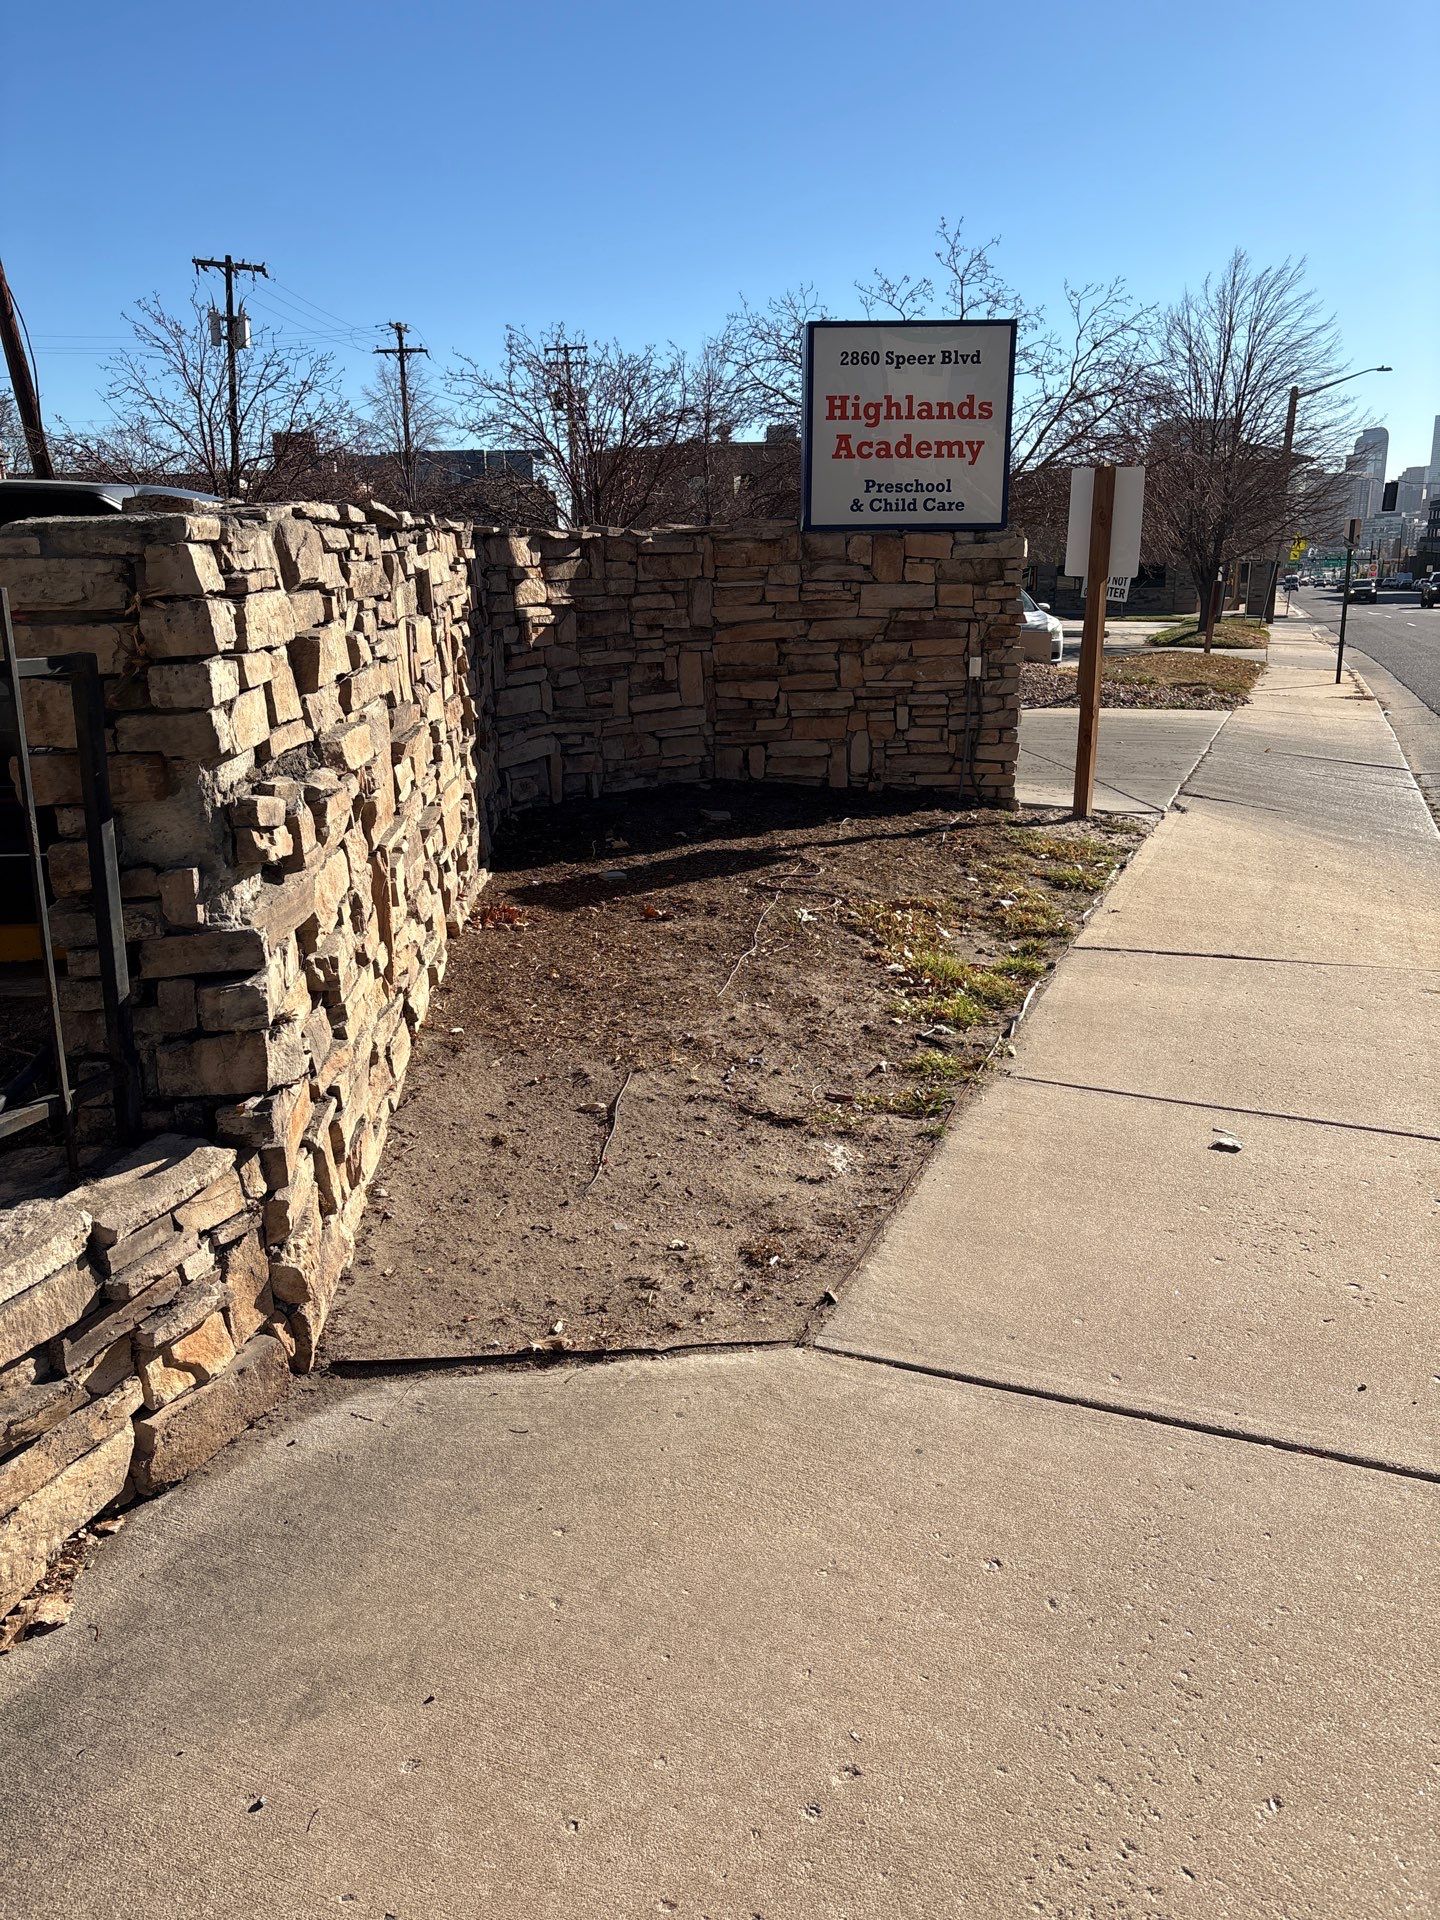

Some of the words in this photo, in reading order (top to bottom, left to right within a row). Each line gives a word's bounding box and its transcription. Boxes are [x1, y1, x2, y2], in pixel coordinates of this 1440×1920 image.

[840, 351, 880, 366] 2860
[885, 350, 936, 369] Speer
[940, 350, 982, 365] Blvd
[825, 394, 993, 428] Highlands
[831, 433, 985, 466] Academy
[864, 479, 952, 493] Preschool
[849, 498, 864, 512] &
[869, 498, 917, 512] Child
[923, 498, 965, 512] Care
[1112, 577, 1128, 586] NOT
[1107, 587, 1126, 599] TER
